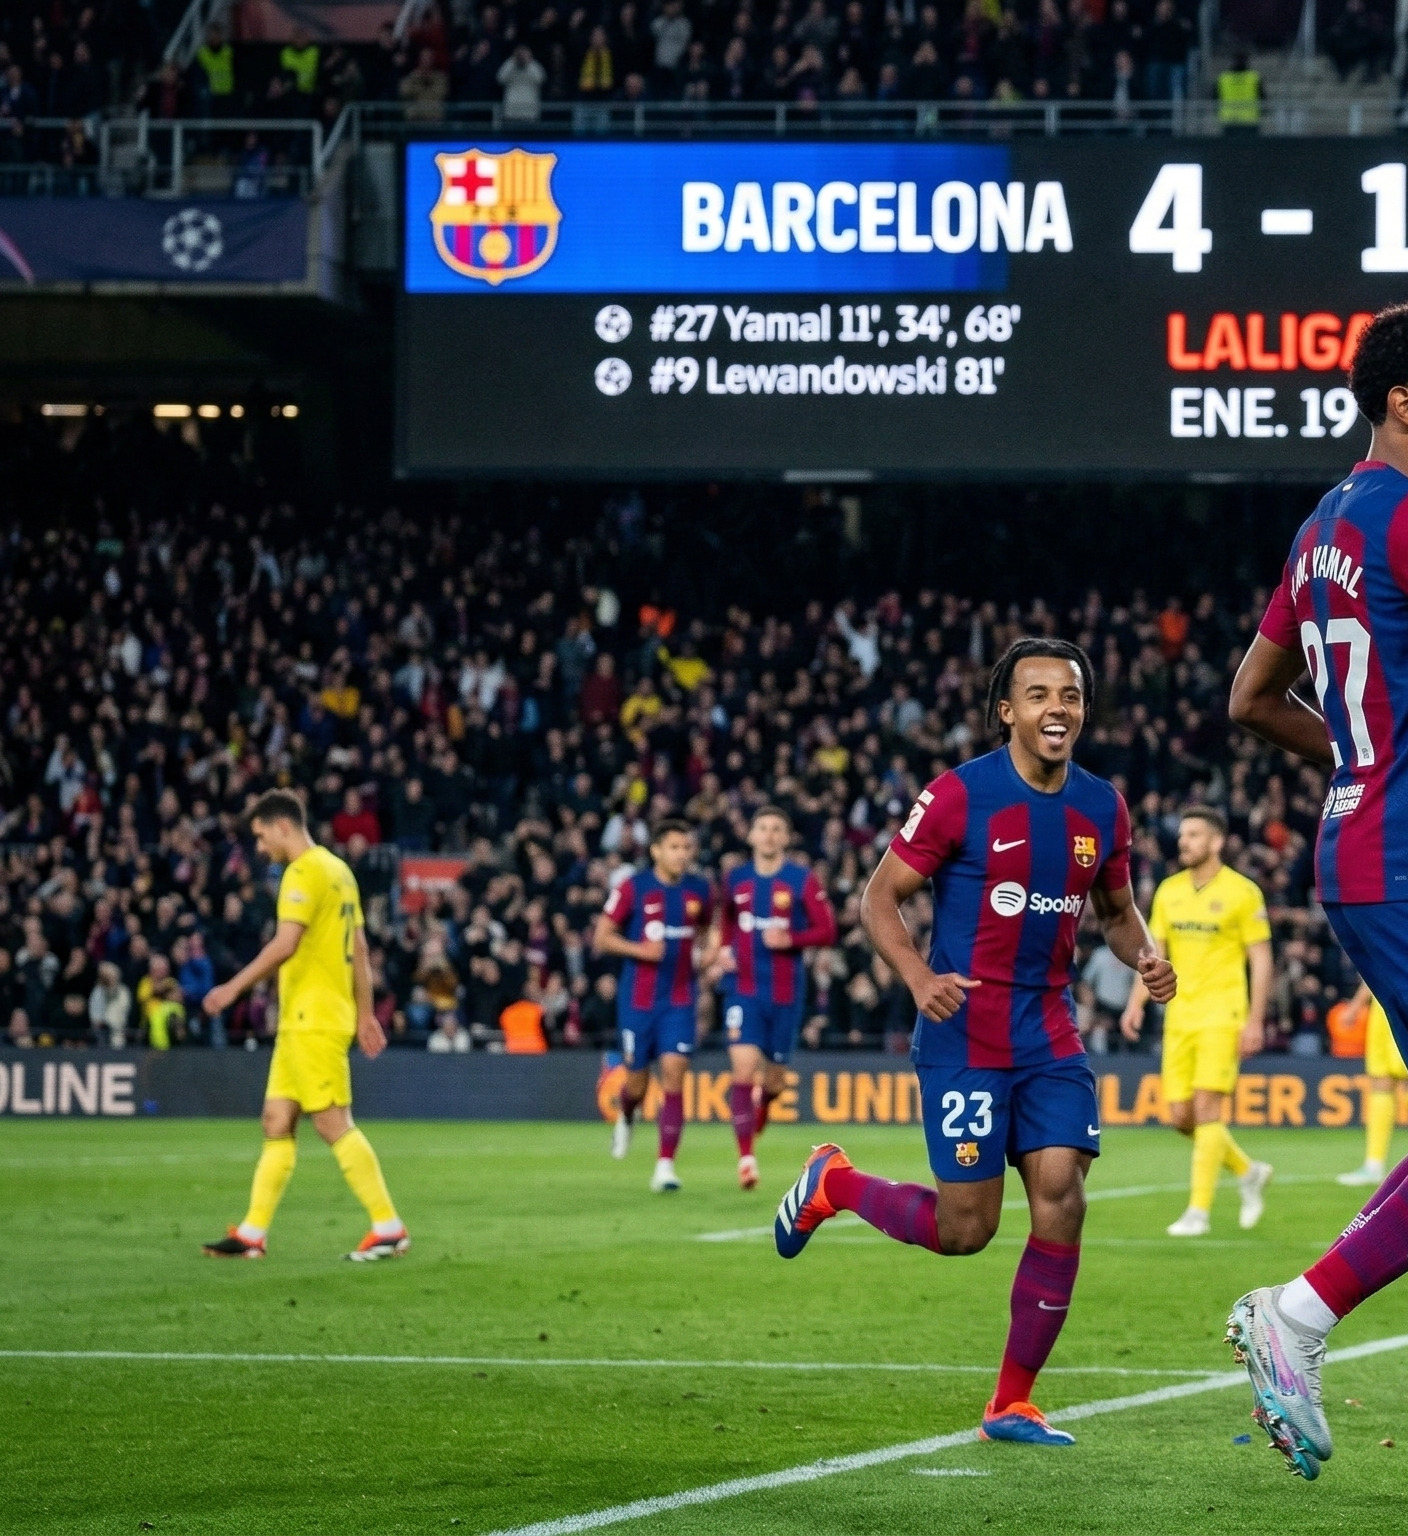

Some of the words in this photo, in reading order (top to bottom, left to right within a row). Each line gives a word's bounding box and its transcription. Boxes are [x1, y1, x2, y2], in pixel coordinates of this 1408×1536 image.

[681, 180, 1075, 254] BARCELONA
[1128, 162, 1214, 273] 4
[649, 304, 719, 342] #27
[722, 303, 832, 343] Yamal
[838, 304, 890, 348] 11',
[895, 304, 959, 348] 34',
[963, 304, 1022, 343] 68'
[649, 356, 700, 394] #9
[706, 355, 948, 395] Lewandowski
[953, 356, 1006, 395] 81'
[1169, 386, 1290, 438] ENE.
[1299, 386, 1359, 438] 19
[1312, 544, 1364, 599] YAMAL
[1028, 892, 1084, 918] Spotify
[941, 1090, 994, 1138] 23
